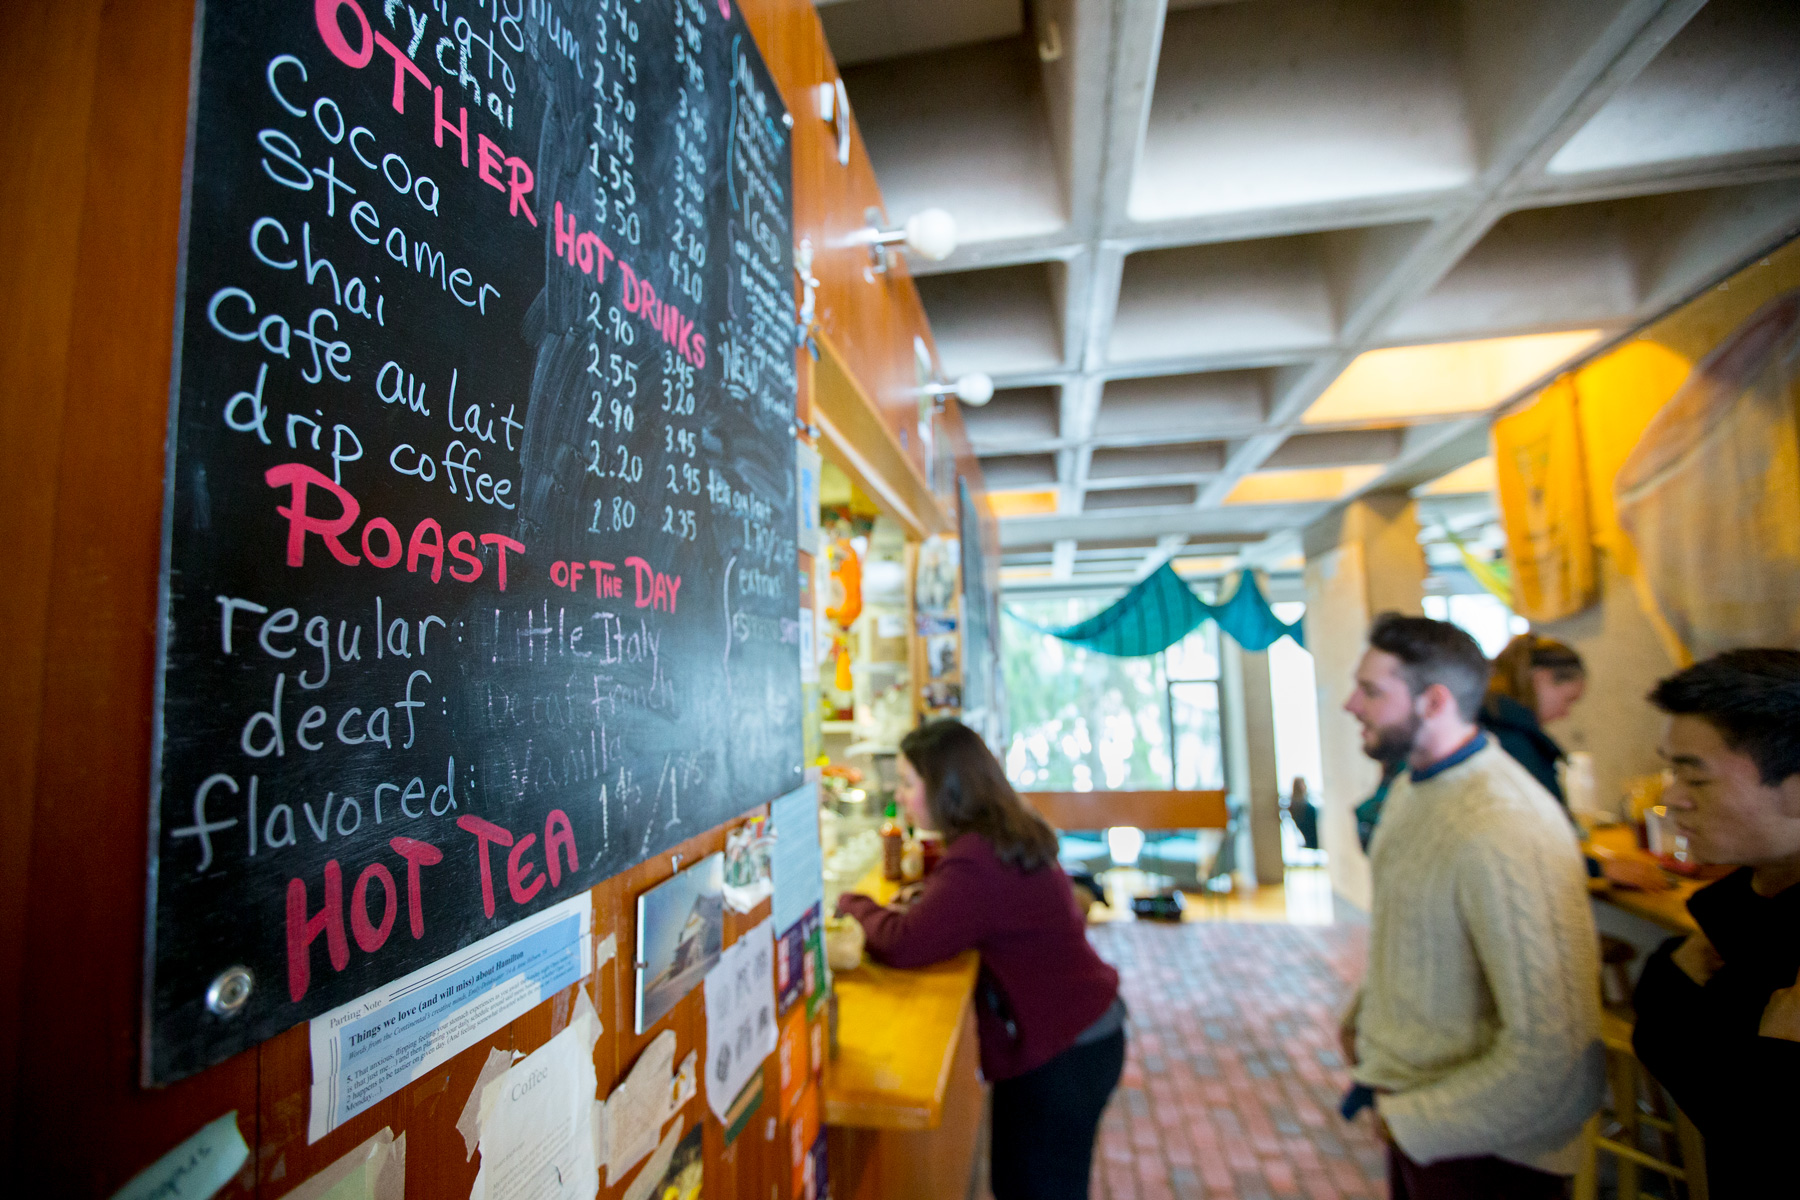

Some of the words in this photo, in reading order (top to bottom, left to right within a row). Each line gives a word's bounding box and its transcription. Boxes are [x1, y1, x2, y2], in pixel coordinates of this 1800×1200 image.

[596, 13, 637, 84] 3.45
[436, 36, 514, 130] chai
[267, 55, 439, 216] Cocoa
[593, 103, 634, 166] 1.45
[315, 0, 537, 227] OTHER
[554, 200, 614, 284] HOT
[618, 260, 706, 369] DRINKS
[589, 142, 636, 206] 1.55
[258, 129, 500, 315] Steamer
[595, 187, 640, 245] 3.50
[250, 217, 385, 326] Chai
[587, 291, 634, 345] 2.90
[207, 287, 351, 384] Cafe
[376, 361, 430, 416] au
[448, 368, 524, 451] lait
[587, 343, 638, 398] 2.55
[663, 350, 694, 389] 3.45
[223, 363, 363, 485] drip
[390, 440, 515, 509] coffee
[588, 391, 634, 434] 2.90
[586, 440, 643, 483] 2.20
[264, 463, 526, 592] ROAST
[550, 560, 585, 592] OF
[589, 560, 623, 599] THE
[624, 556, 681, 614] DAY
[588, 496, 635, 532] 1.80
[286, 837, 443, 1003] HOT
[456, 809, 579, 919] TEA
[330, 1009, 361, 1028] Parting
[363, 1000, 382, 1013] Note
[348, 1024, 381, 1047] Things
[383, 1016, 396, 1028] we
[398, 1006, 416, 1022] love
[418, 994, 438, 1013] (and
[440, 986, 454, 1000] will
[456, 976, 475, 992] miss)
[476, 966, 495, 982] about
[496, 951, 524, 971] Hamilton
[352, 1080, 378, 1101] happens
[353, 1078, 366, 1090] that
[366, 1070, 378, 1084] just
[354, 1066, 369, 1079] That
[511, 1066, 548, 1102] Coffee
